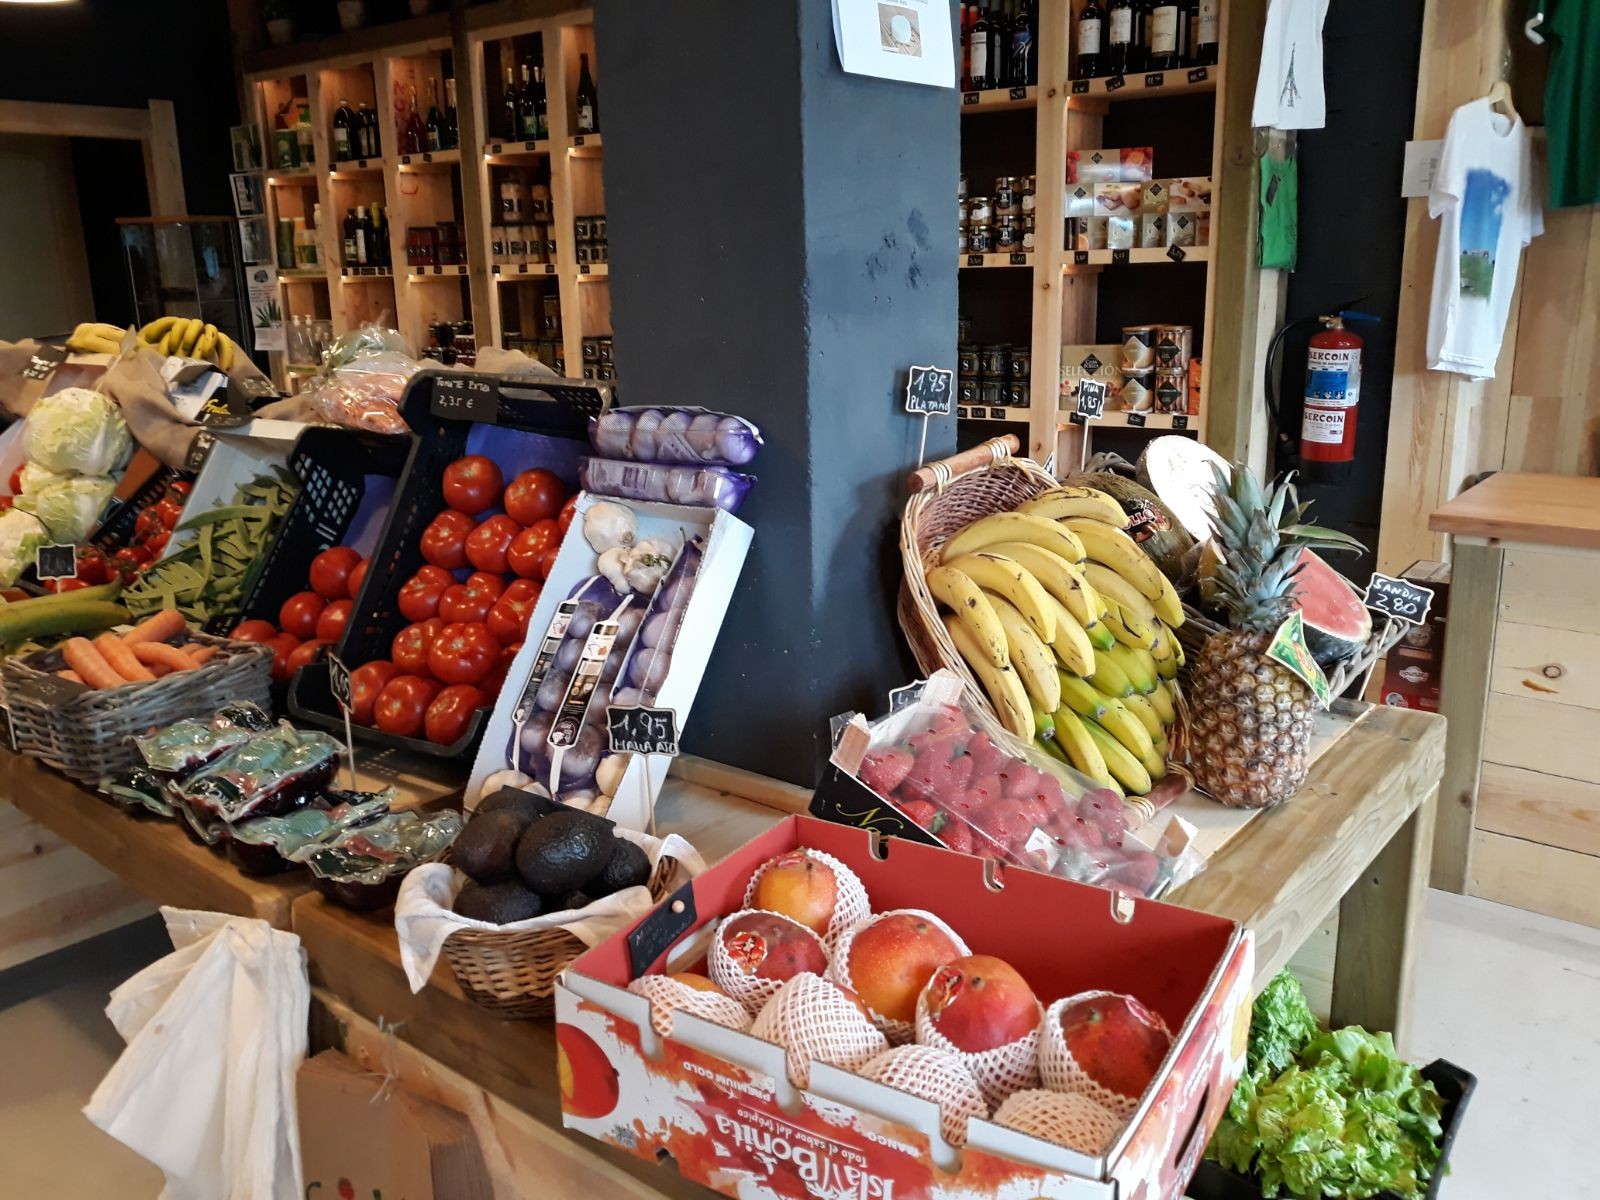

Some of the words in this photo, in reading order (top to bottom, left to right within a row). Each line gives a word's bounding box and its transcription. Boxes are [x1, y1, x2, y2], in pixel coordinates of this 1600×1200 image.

[1308, 351, 1350, 361] SERCOIN
[913, 371, 948, 396] 1,95
[466, 398, 474, 409] €
[1304, 411, 1344, 423] SERCOIN
[1372, 578, 1422, 603] SANDIA
[611, 712, 668, 739] 1,95
[683, 1060, 715, 1080] GOLD
[737, 1108, 774, 1131] trópico
[776, 1126, 792, 1140] del
[794, 1131, 826, 1150] sabor
[714, 1113, 819, 1182] Bonita
[829, 1143, 839, 1156] el
[868, 1132, 922, 1158] MANGO
[842, 1149, 868, 1168] Todo
[843, 1166, 896, 1200] Isla
